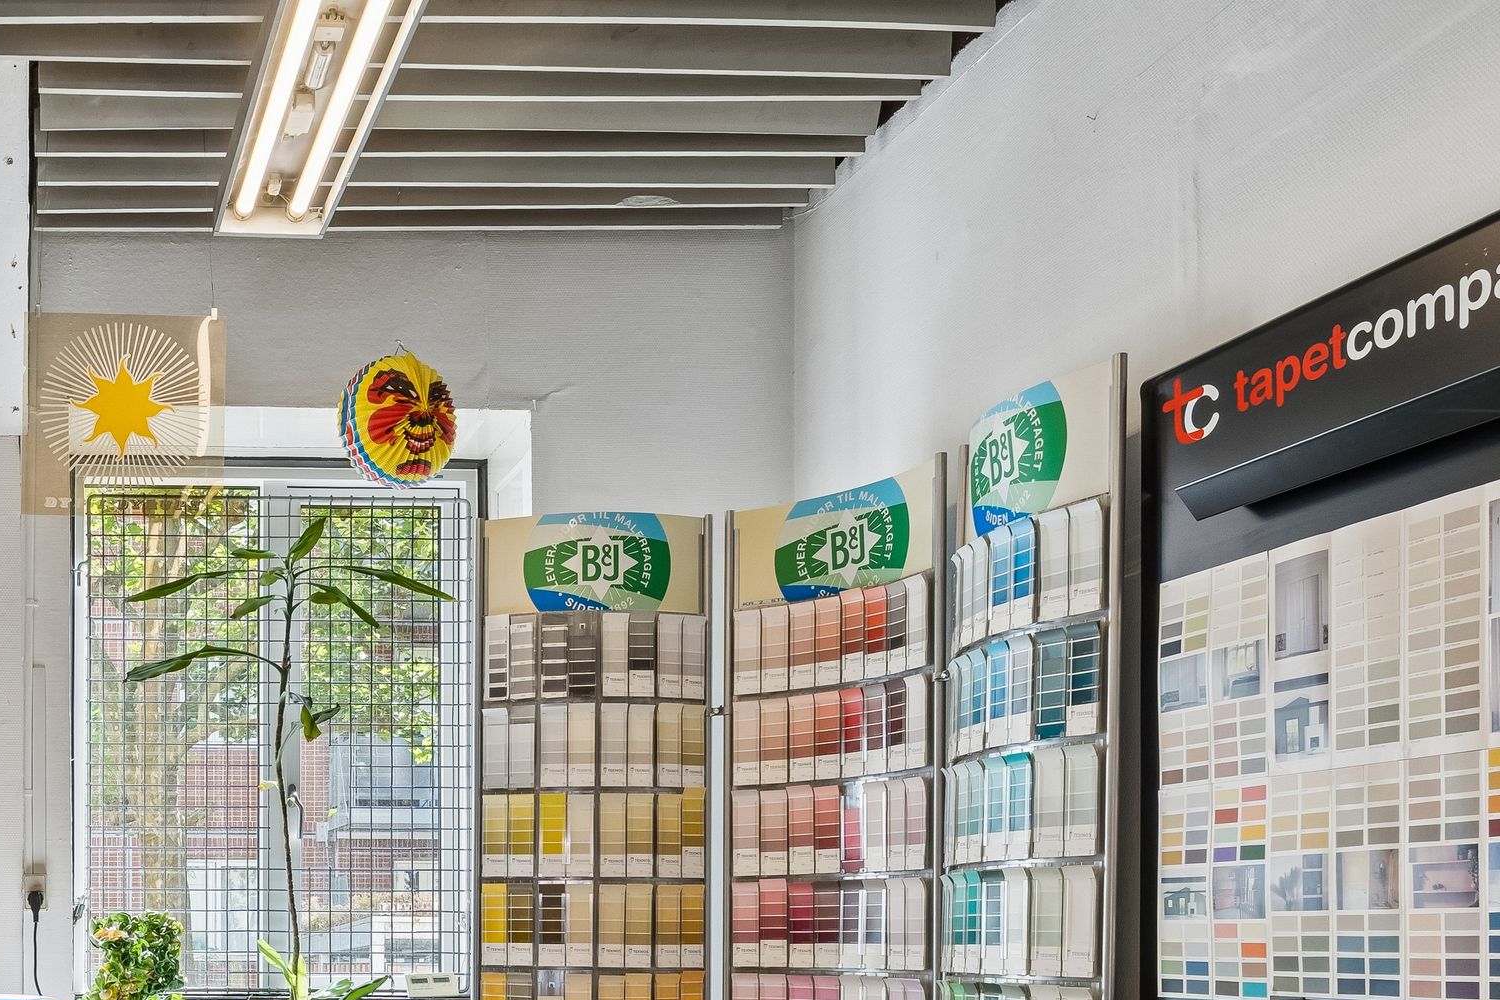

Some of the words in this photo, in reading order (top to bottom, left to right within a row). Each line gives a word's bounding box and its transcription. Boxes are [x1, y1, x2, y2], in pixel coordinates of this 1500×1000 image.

[1233, 263, 1500, 412] tapetcomp
[989, 428, 1016, 487] B&J
[1010, 394, 1045, 472] ALERFAGET
[614, 513, 651, 588] MALERFAGET
[830, 523, 866, 571] B&J
[859, 490, 894, 561] MALERFAGET
[985, 510, 1009, 526] SIDEN
[582, 543, 620, 582] B&J
